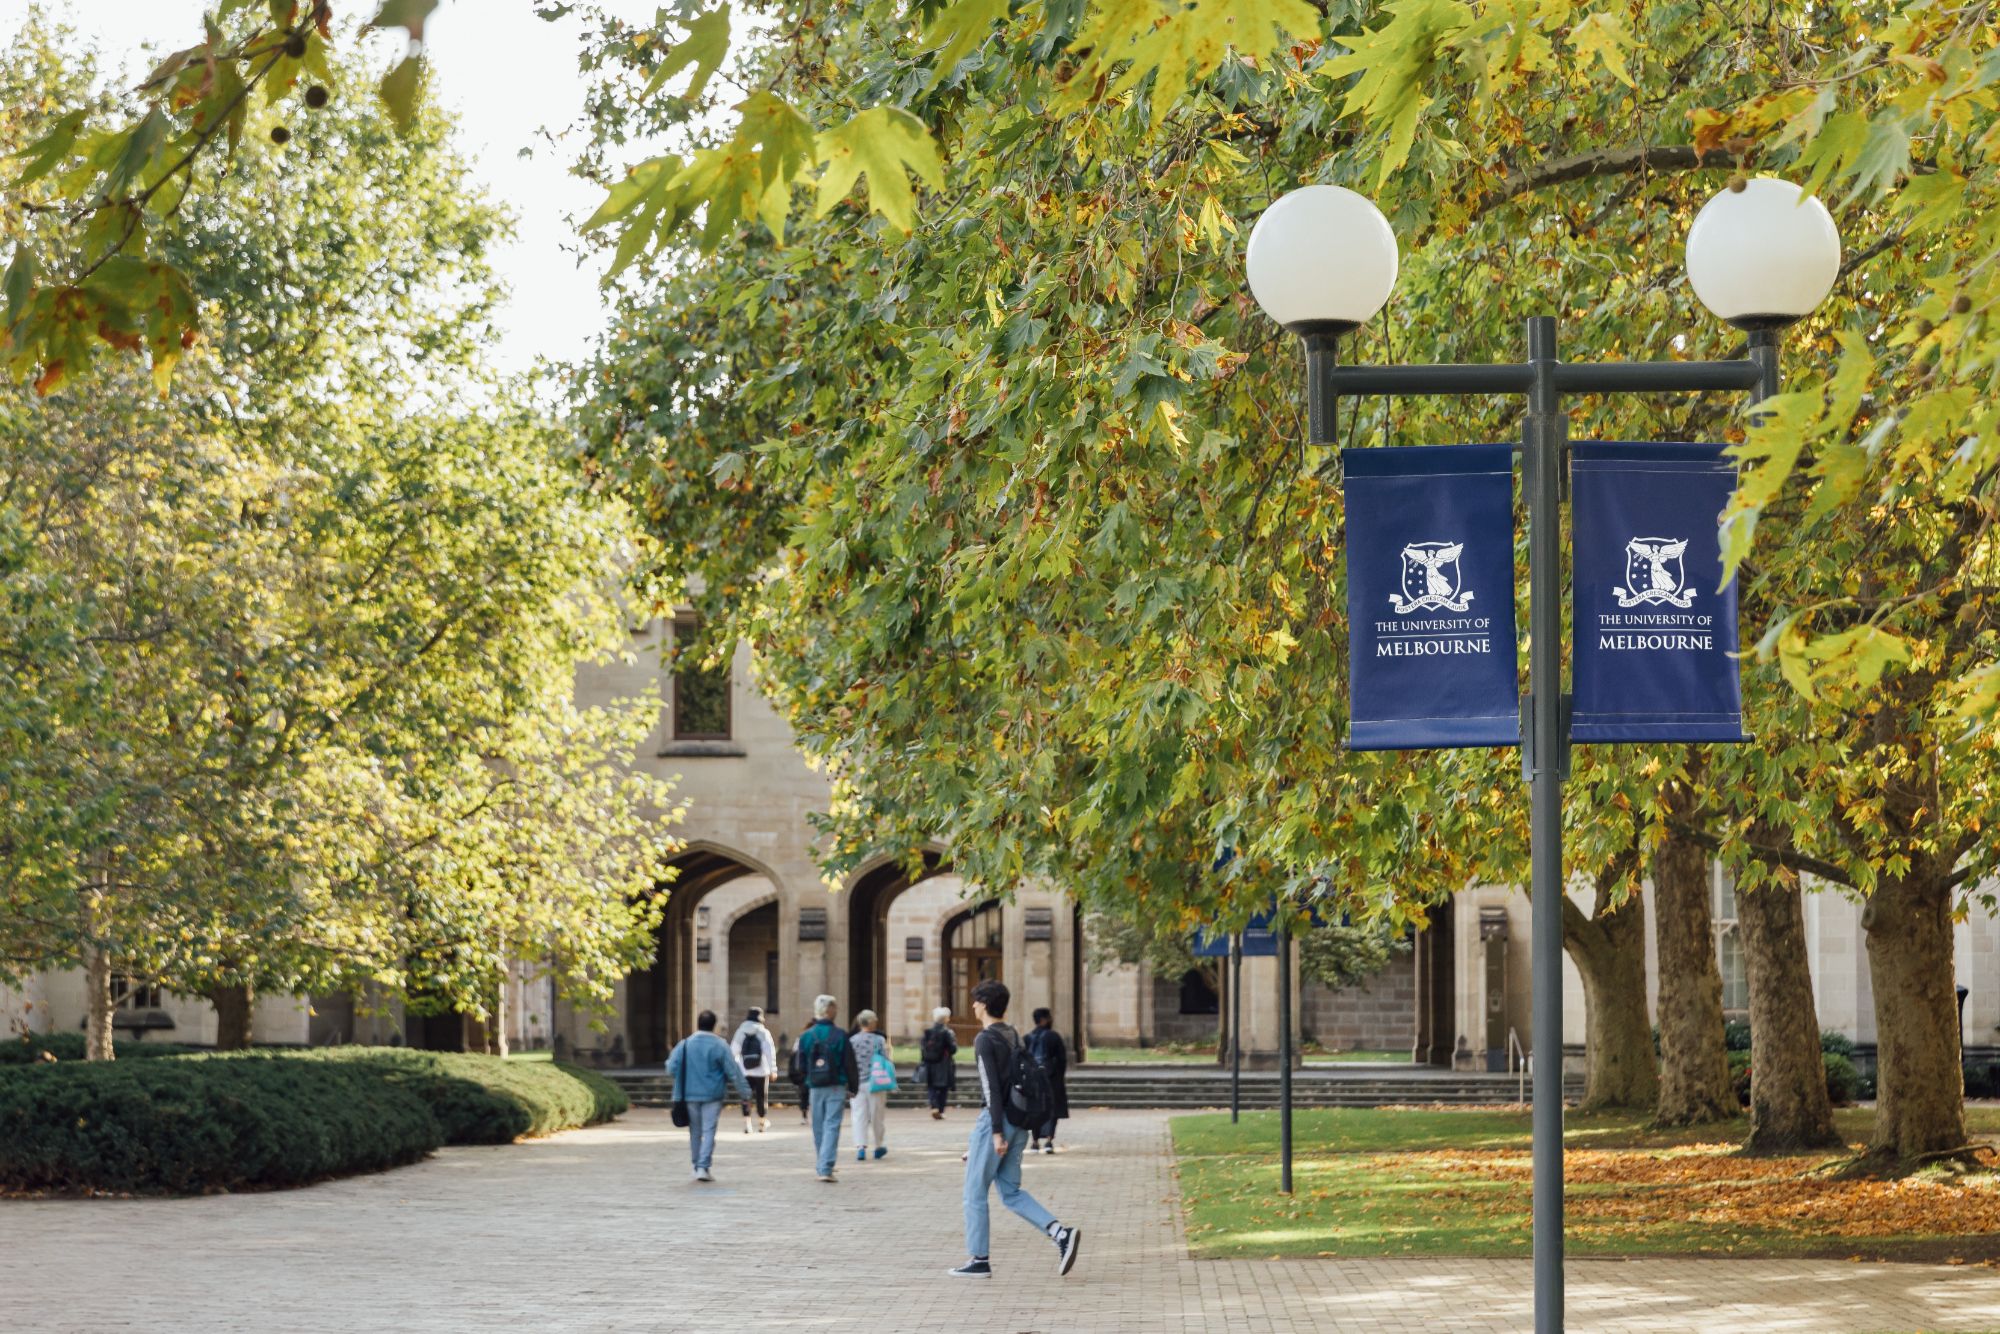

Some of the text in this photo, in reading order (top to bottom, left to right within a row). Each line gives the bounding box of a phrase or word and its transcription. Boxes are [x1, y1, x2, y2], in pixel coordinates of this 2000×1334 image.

[1375, 618, 1490, 632] THE UNIVERSITY OF
[1598, 614, 1713, 626] THE UNIVERSITY OF
[1376, 639, 1491, 656] MELBOURNE
[1599, 635, 1713, 650] MELBOURNE
